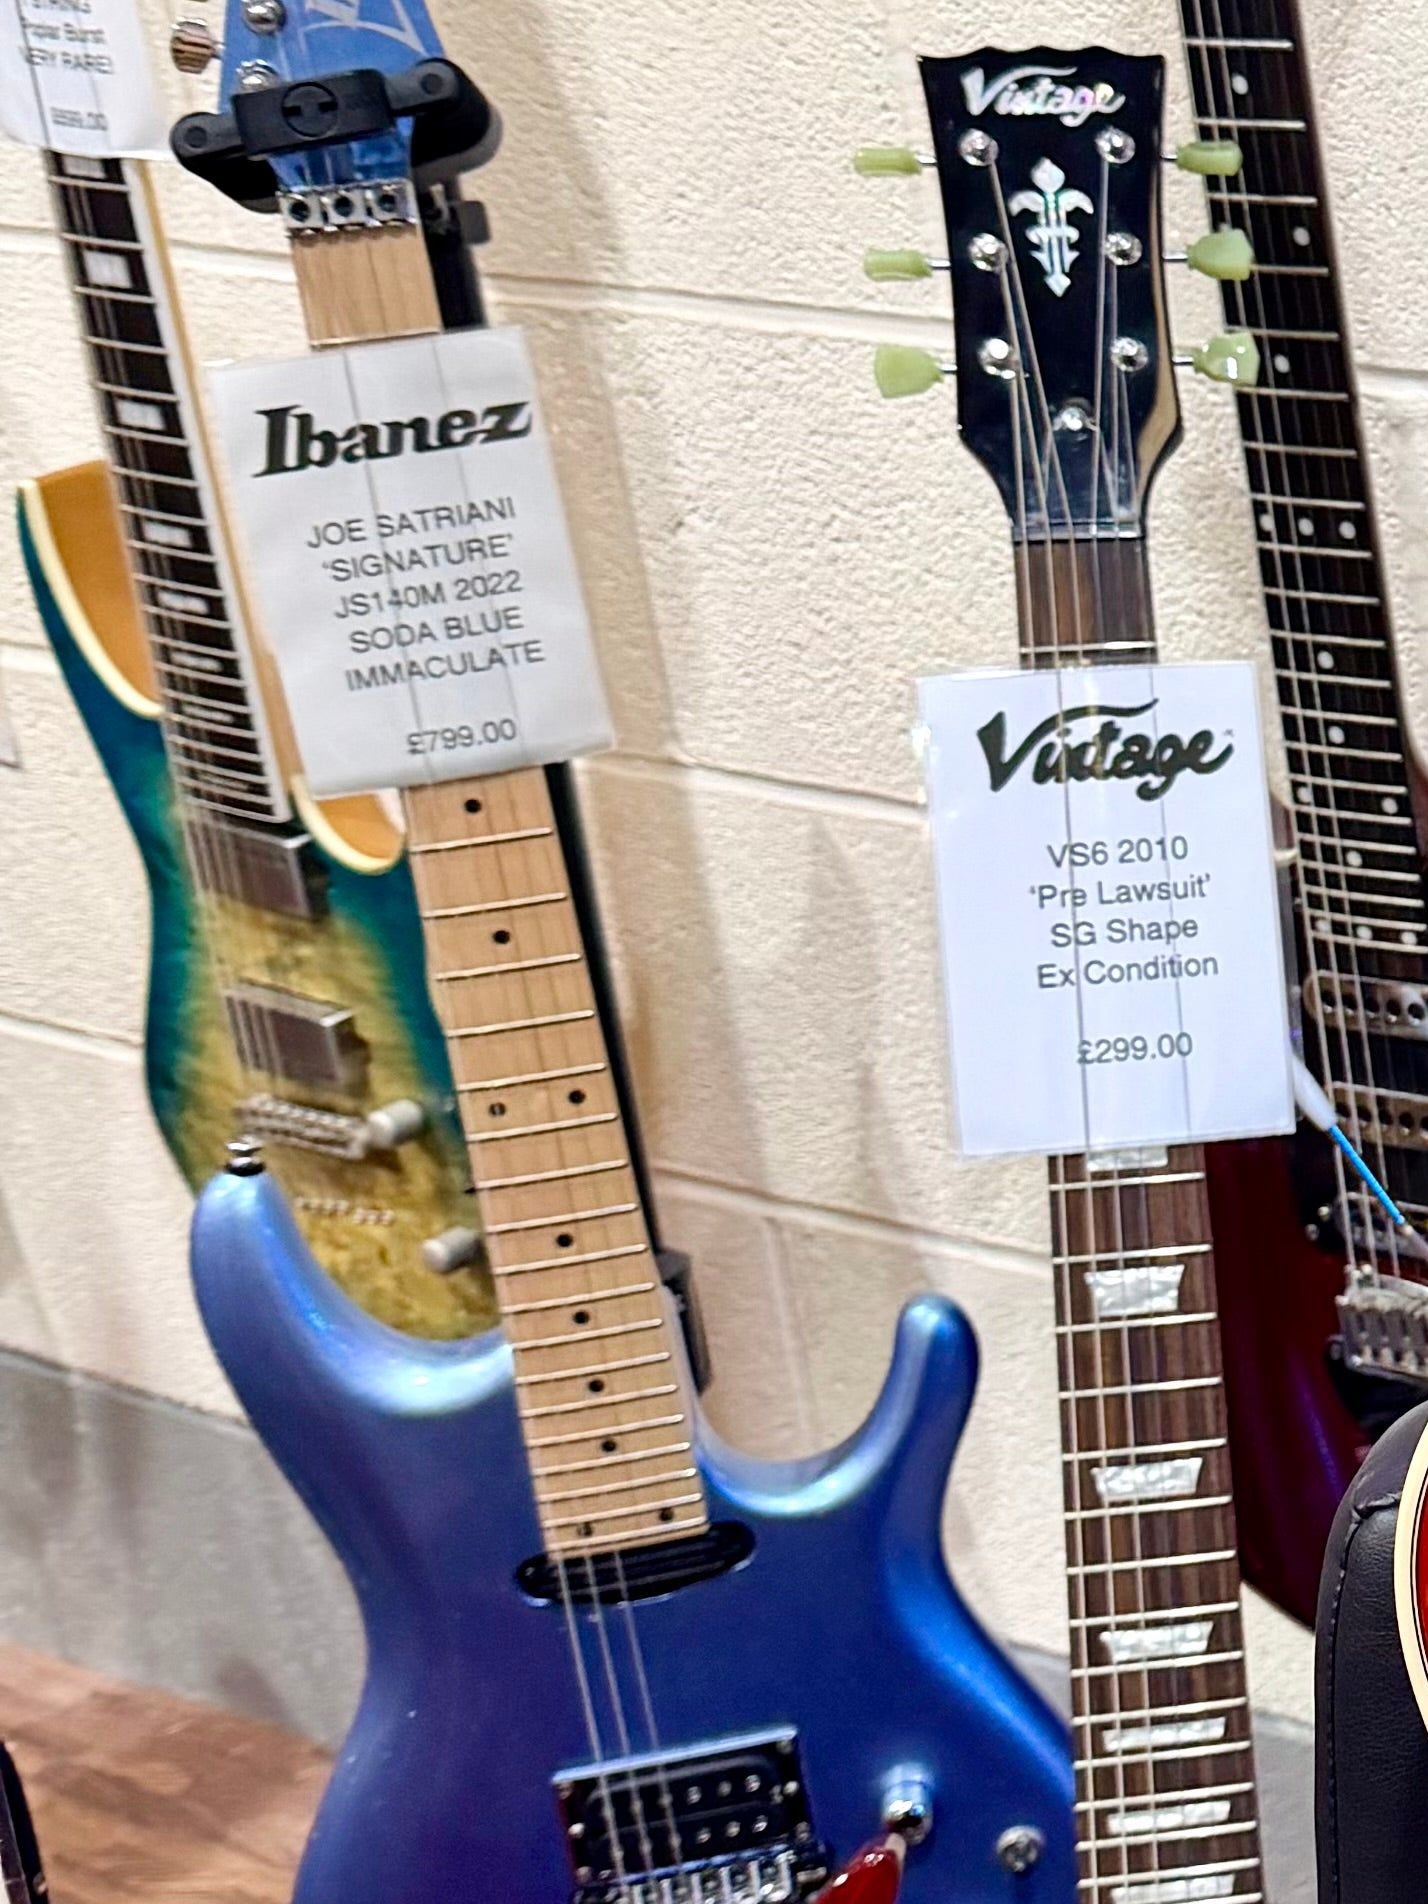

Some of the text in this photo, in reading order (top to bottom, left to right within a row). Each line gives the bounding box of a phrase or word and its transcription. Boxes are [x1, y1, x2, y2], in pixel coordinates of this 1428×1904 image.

[960, 64, 1127, 128] Vintage
[252, 400, 533, 479] Ibanez
[306, 496, 517, 550] JOE SATRIANI
[334, 569, 524, 621] JS140M 2022
[348, 605, 525, 654] SODA BLUE
[343, 639, 546, 693] IMMACULATE
[406, 718, 518, 757] £799.00
[976, 697, 1236, 802] Vintage
[1046, 834, 1189, 869] VS6 2010
[1050, 916, 1200, 949] SG Shape
[1037, 954, 1220, 990] Ex Condition
[1076, 1031, 1194, 1066] £299.00
